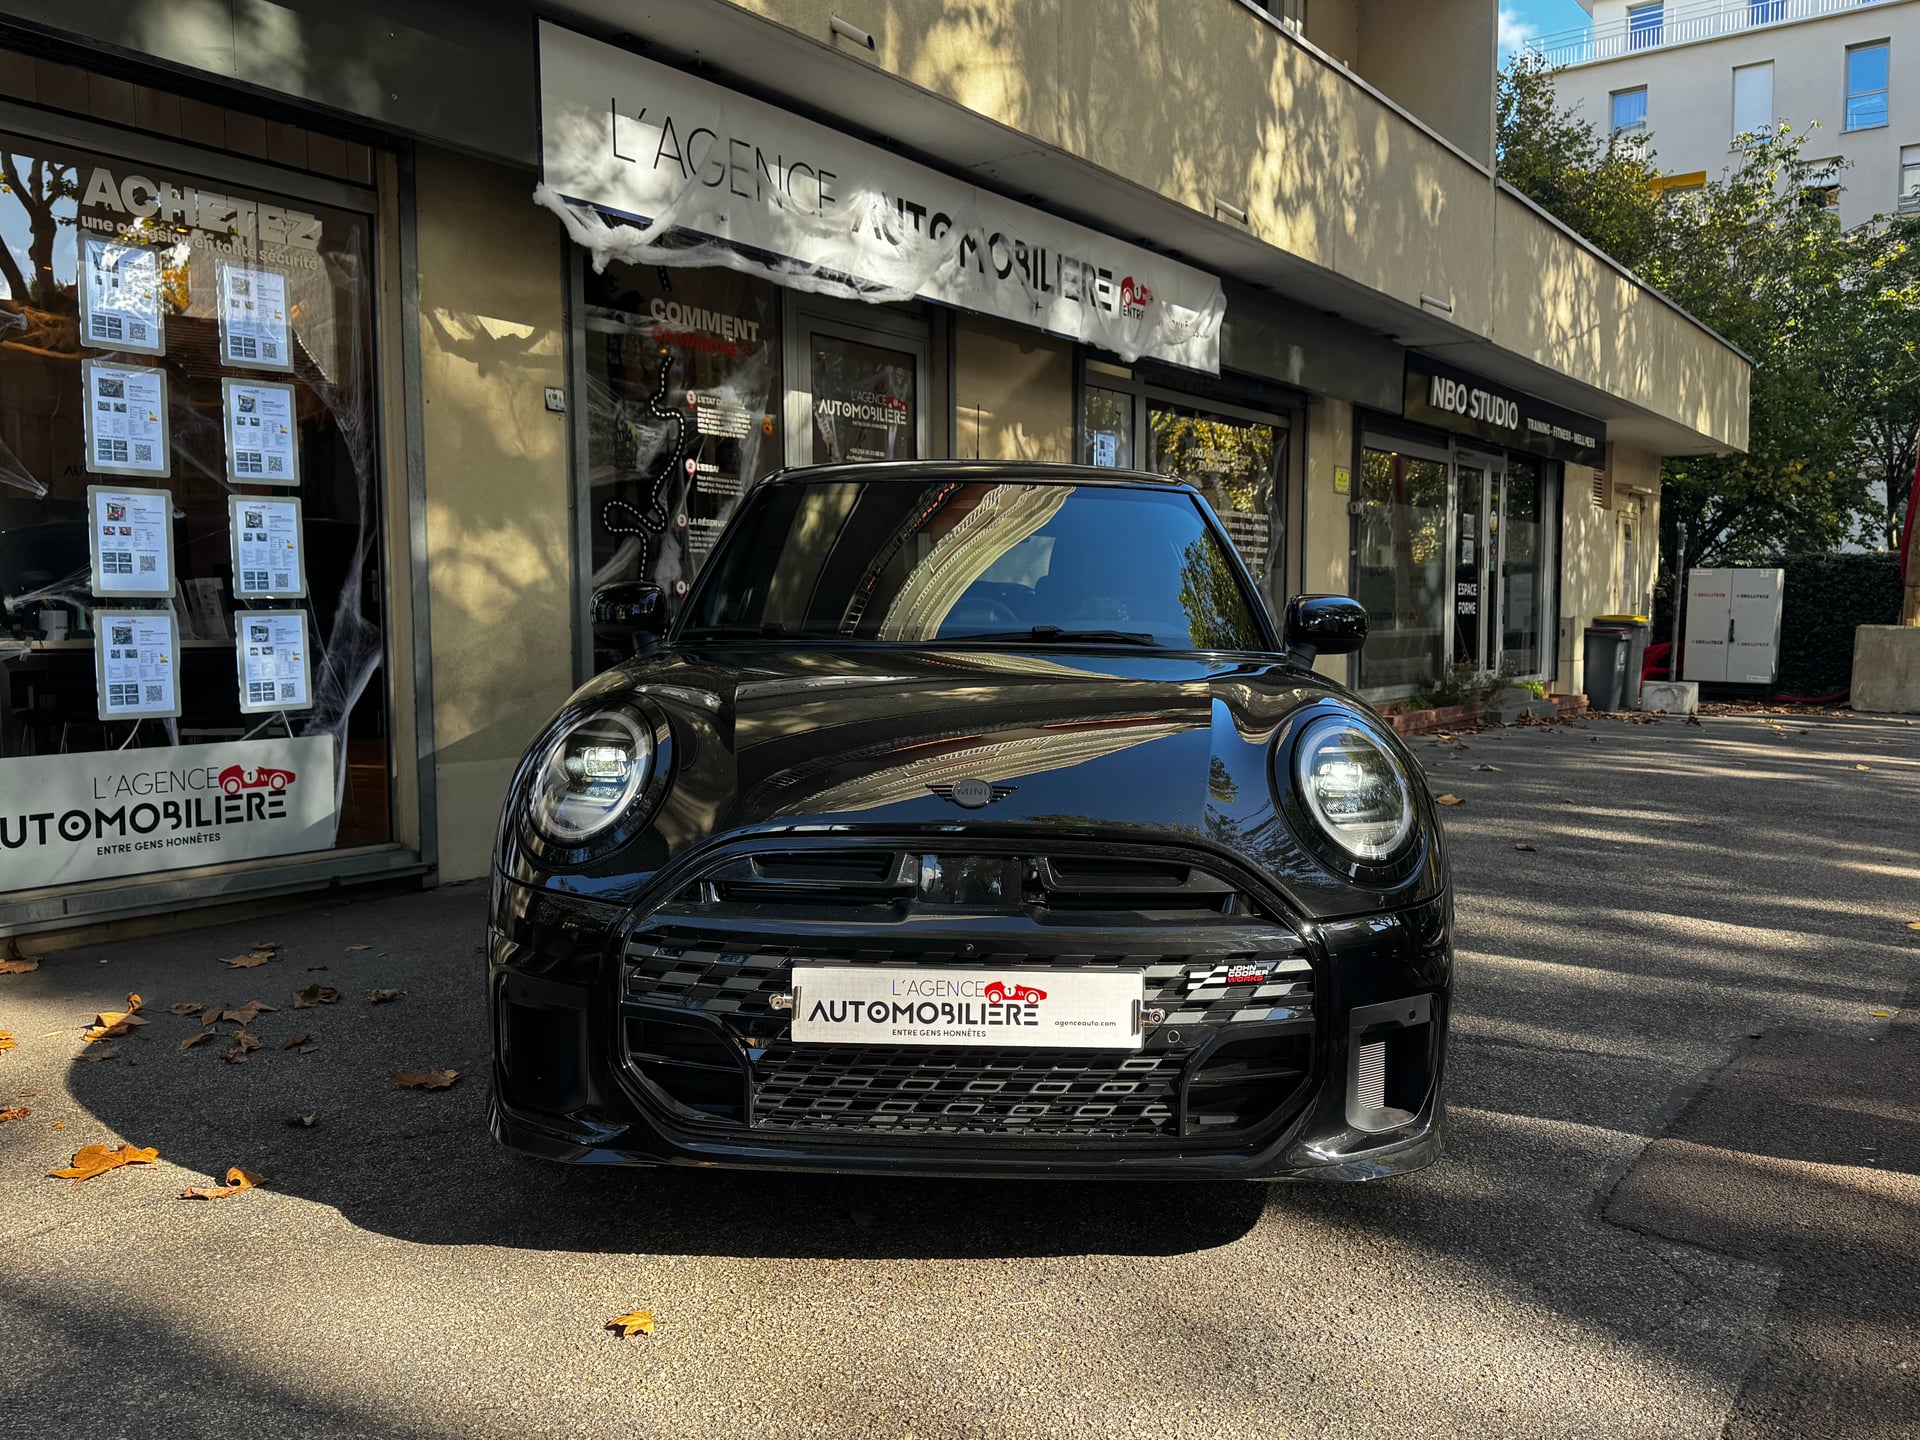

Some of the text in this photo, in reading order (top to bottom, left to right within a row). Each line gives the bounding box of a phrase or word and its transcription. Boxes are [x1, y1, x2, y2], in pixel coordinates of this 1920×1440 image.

[612, 97, 837, 218] L'AGENCE
[82, 167, 319, 250] ACHETEZ
[81, 215, 113, 232] une
[117, 223, 191, 246] occasion
[196, 235, 215, 251] en
[259, 247, 318, 271] sécurité
[650, 298, 759, 342] COMMENT
[1431, 375, 1518, 430] NBO STUDIO
[1527, 417, 1550, 435] TRAINING
[1553, 425, 1571, 441] FITNESS
[1458, 583, 1477, 596] ESPACE
[1458, 601, 1476, 614] FORME
[93, 767, 219, 799] L'AGENCE
[957, 787, 987, 796] MINI
[0, 789, 287, 850] UTOMOBILIERE
[97, 832, 221, 856] ENTRE GENS HONNÊTES
[892, 979, 985, 998] L'AGENCE
[808, 1000, 1039, 1026] AUTOMOBILIERE
[1054, 1020, 1117, 1028] agenceauto.com
[892, 1028, 987, 1038] ENTRE GENS HONNÊTES
